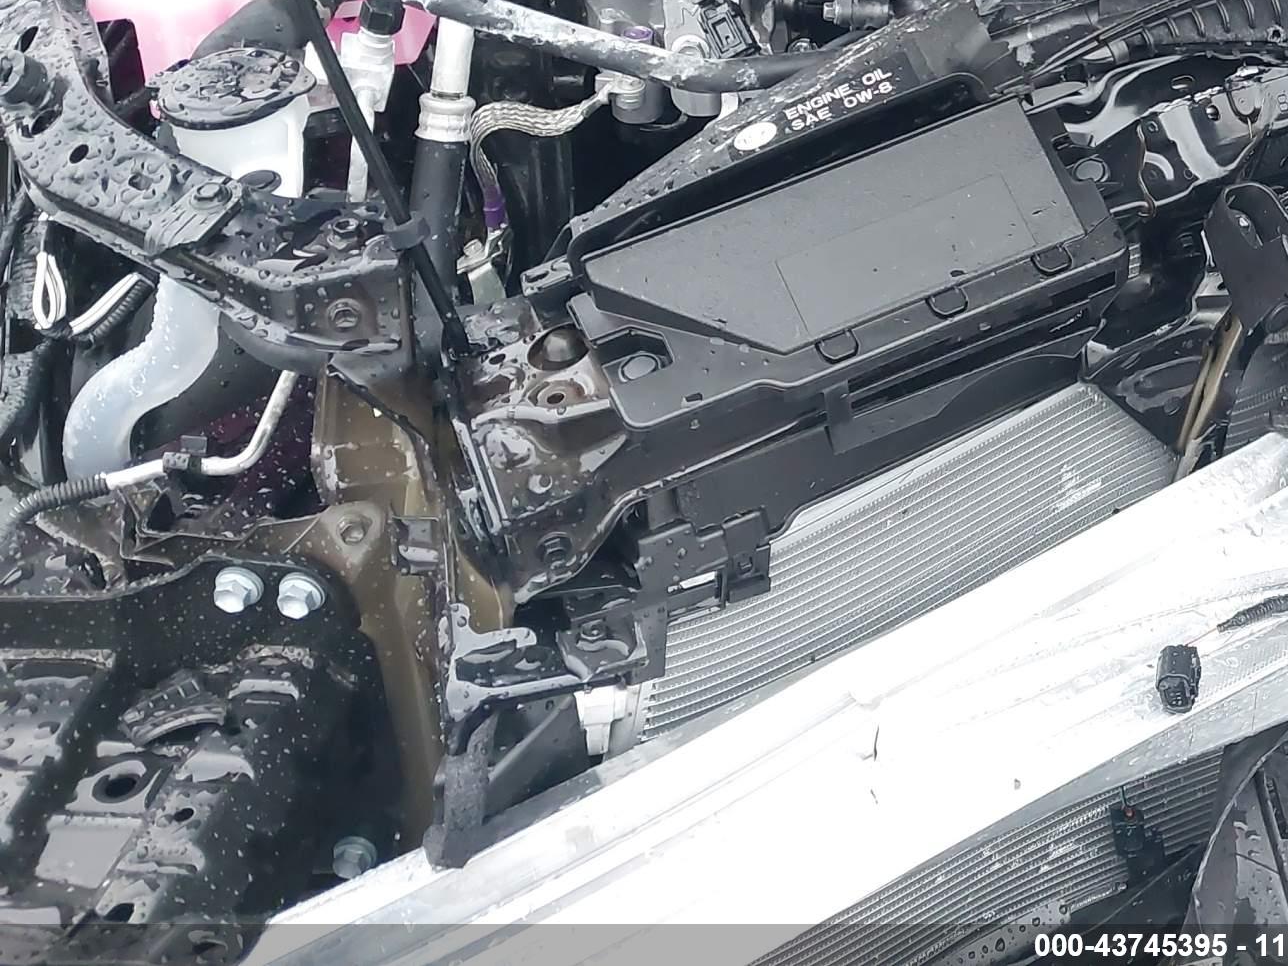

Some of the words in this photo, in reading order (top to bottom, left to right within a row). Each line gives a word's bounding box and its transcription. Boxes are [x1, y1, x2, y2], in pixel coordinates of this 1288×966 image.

[784, 84, 853, 120] ENGINE
[861, 68, 892, 86] OIL
[792, 107, 833, 132] SAE
